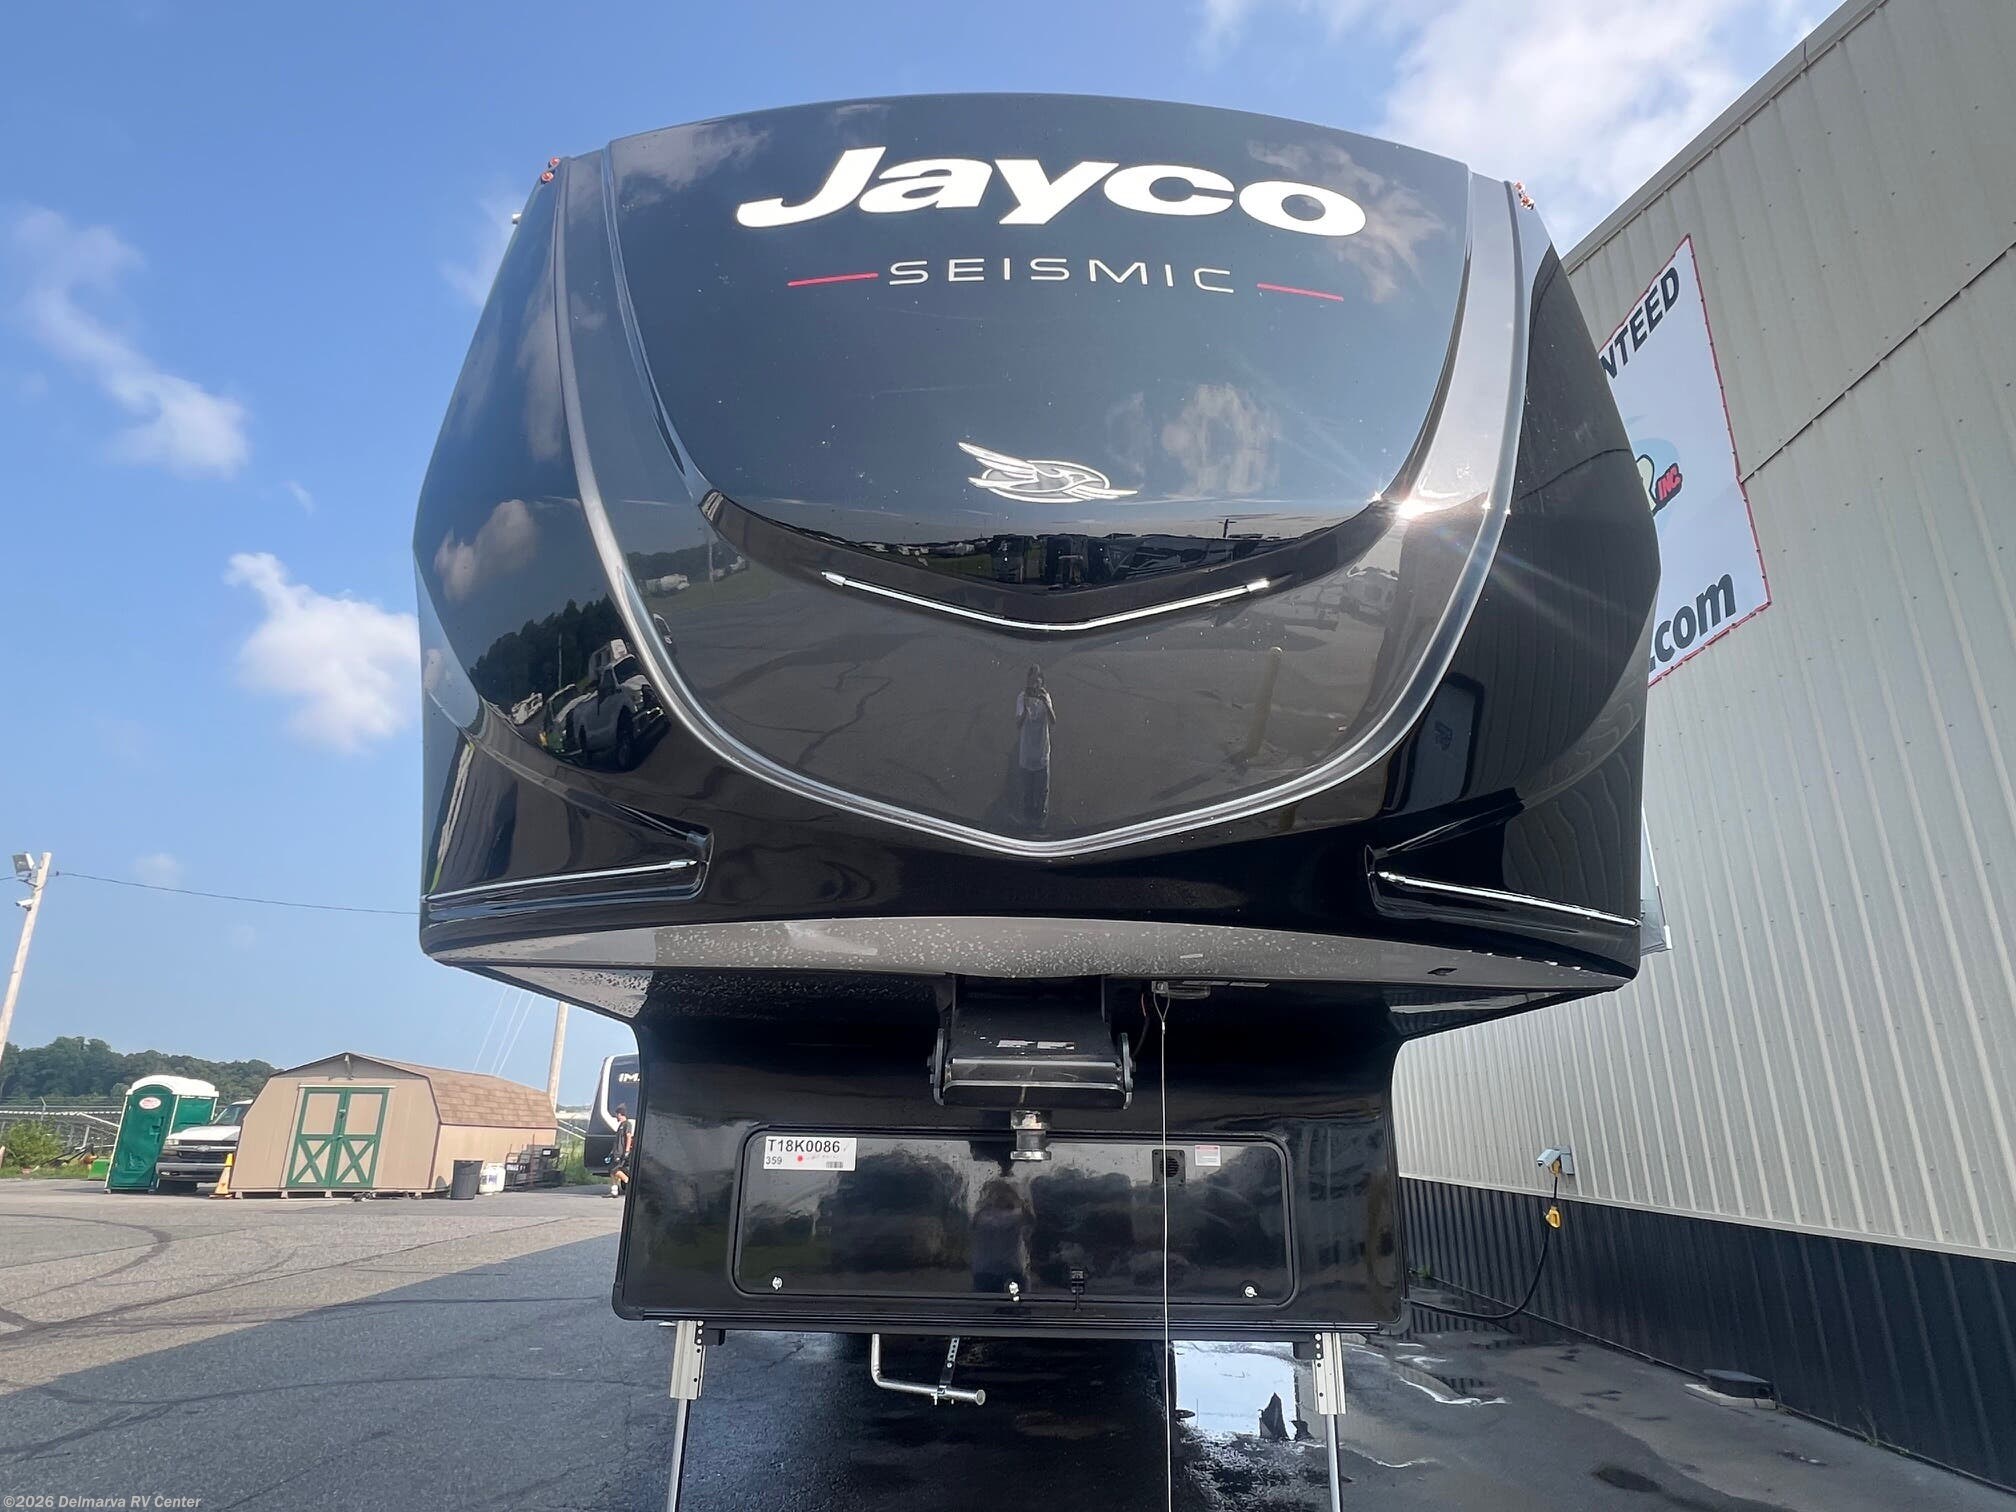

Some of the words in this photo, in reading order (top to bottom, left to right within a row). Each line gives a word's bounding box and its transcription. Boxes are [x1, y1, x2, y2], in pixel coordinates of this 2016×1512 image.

[736, 146, 1367, 236] Jayco
[888, 257, 1234, 293] SEISMIC
[618, 1072, 640, 1082] IM
[767, 1139, 840, 1153] T18K0086
[765, 1156, 782, 1165] 359
